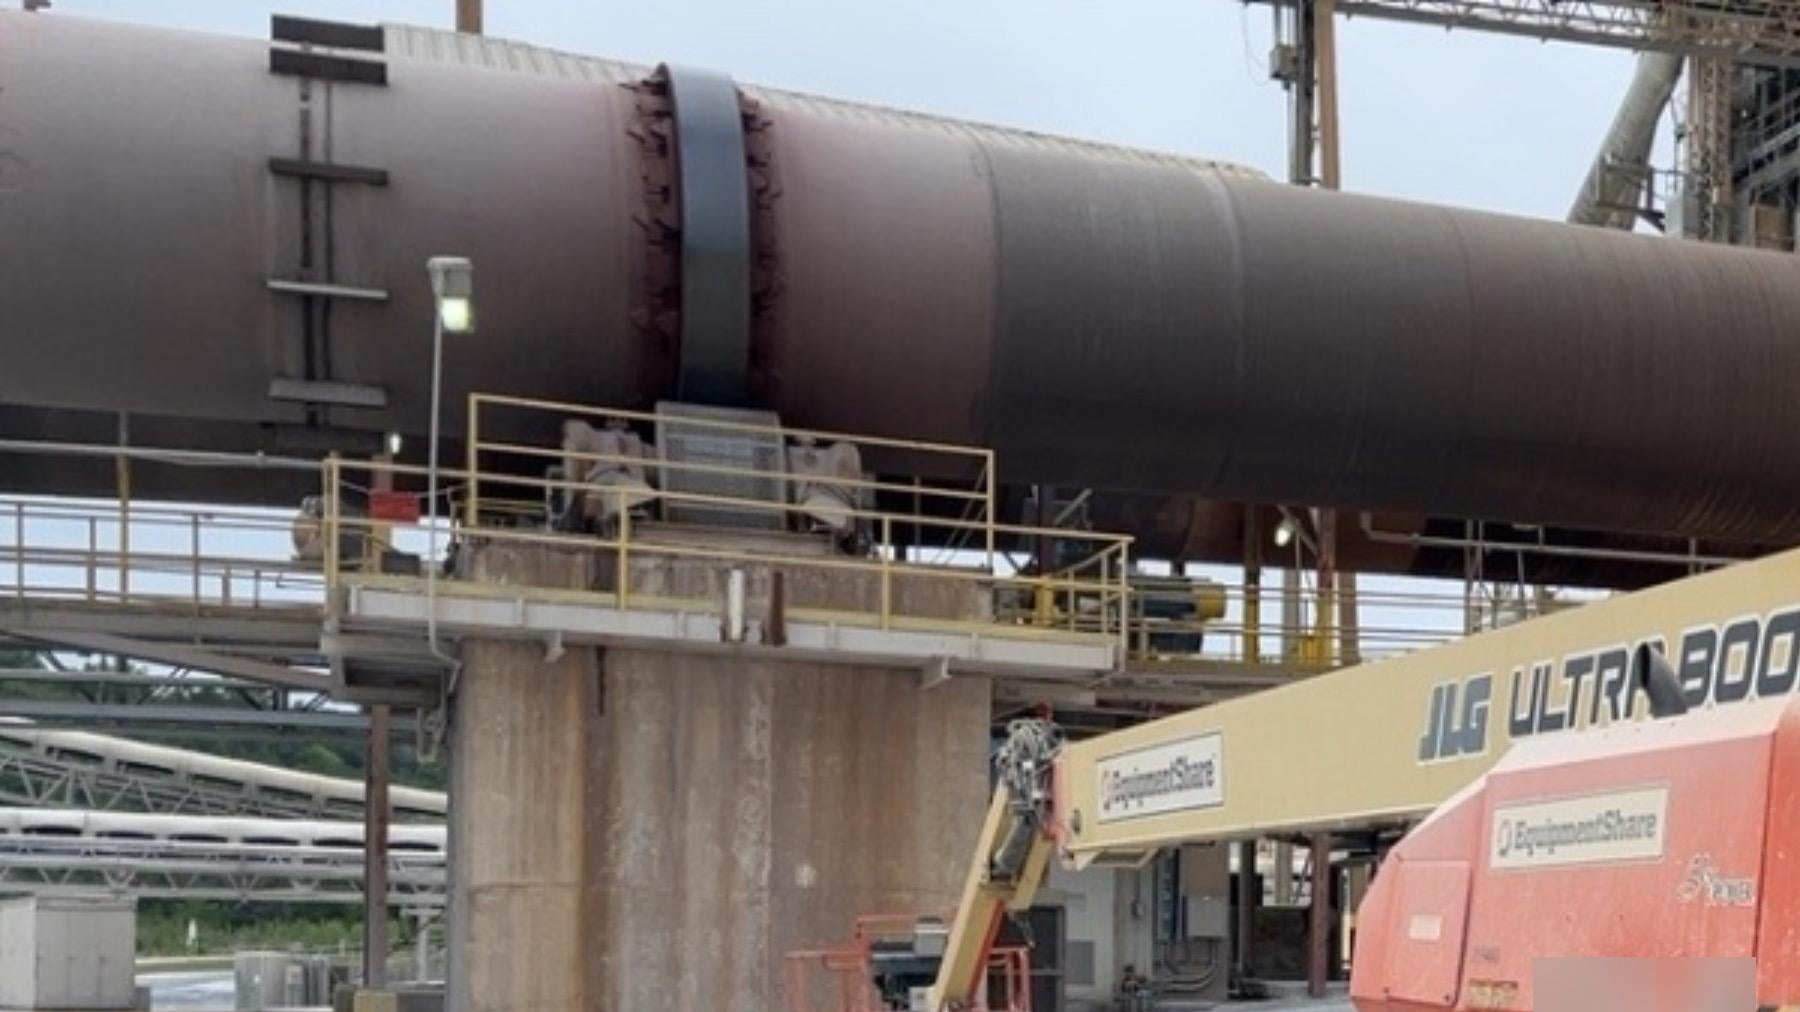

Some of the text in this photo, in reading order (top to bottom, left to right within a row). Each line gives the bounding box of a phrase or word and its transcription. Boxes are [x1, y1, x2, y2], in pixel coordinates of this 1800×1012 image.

[1419, 675, 1493, 761] JLG
[1112, 755, 1214, 810] EquipmentShare
[1514, 808, 1658, 857] EquipmentShare
